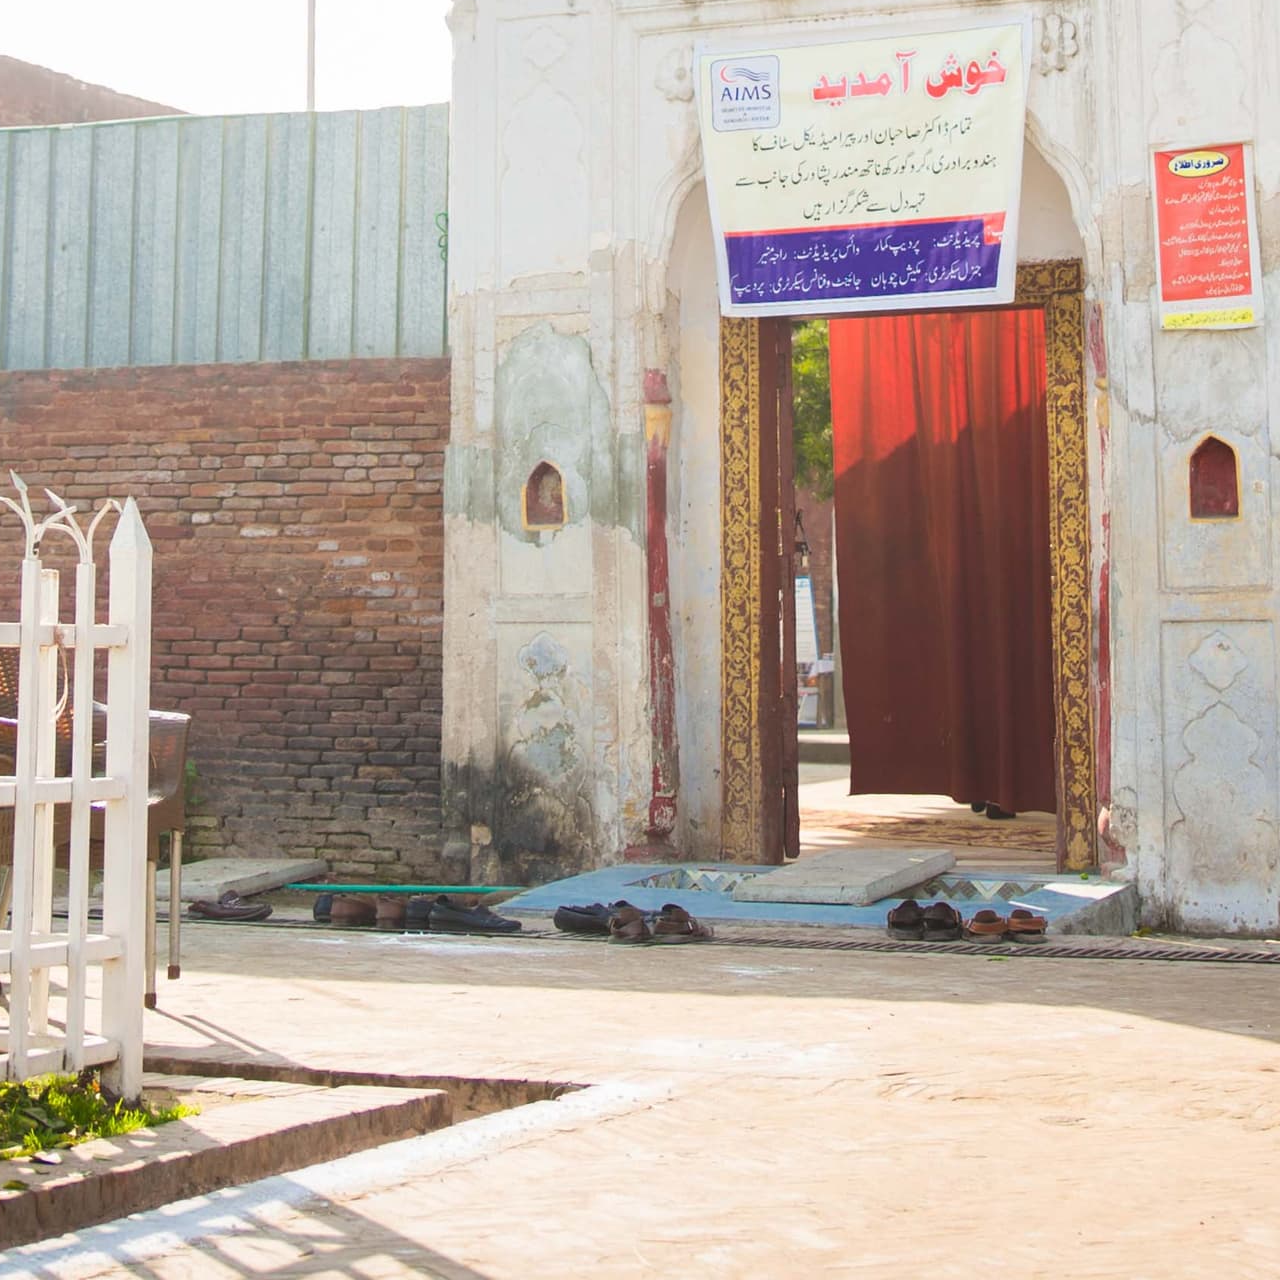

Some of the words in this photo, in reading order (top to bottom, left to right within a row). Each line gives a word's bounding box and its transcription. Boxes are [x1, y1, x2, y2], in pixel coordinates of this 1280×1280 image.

[812, 49, 918, 107] آمدید
[926, 49, 1008, 98] خوش
[721, 83, 772, 102] AIMS
[857, 128, 873, 145] اور
[874, 124, 921, 147] صاحبان
[920, 114, 949, 144] ڈاکٹر
[949, 116, 972, 145] تمام
[751, 135, 763, 152] کا
[760, 135, 793, 151] سٹاف
[858, 159, 881, 177] ناتھ
[974, 154, 997, 169] ہندو
[735, 176, 757, 188] سے
[757, 169, 789, 190] جانب
[791, 159, 808, 186] کی
[803, 165, 832, 187] پشاور
[833, 166, 858, 180] مندر
[803, 202, 822, 221] ہیں
[849, 188, 870, 215] شکر
[866, 202, 888, 213] سے
[890, 190, 910, 213] دل
[874, 234, 894, 253] کمار
[958, 261, 982, 283] جنرل
